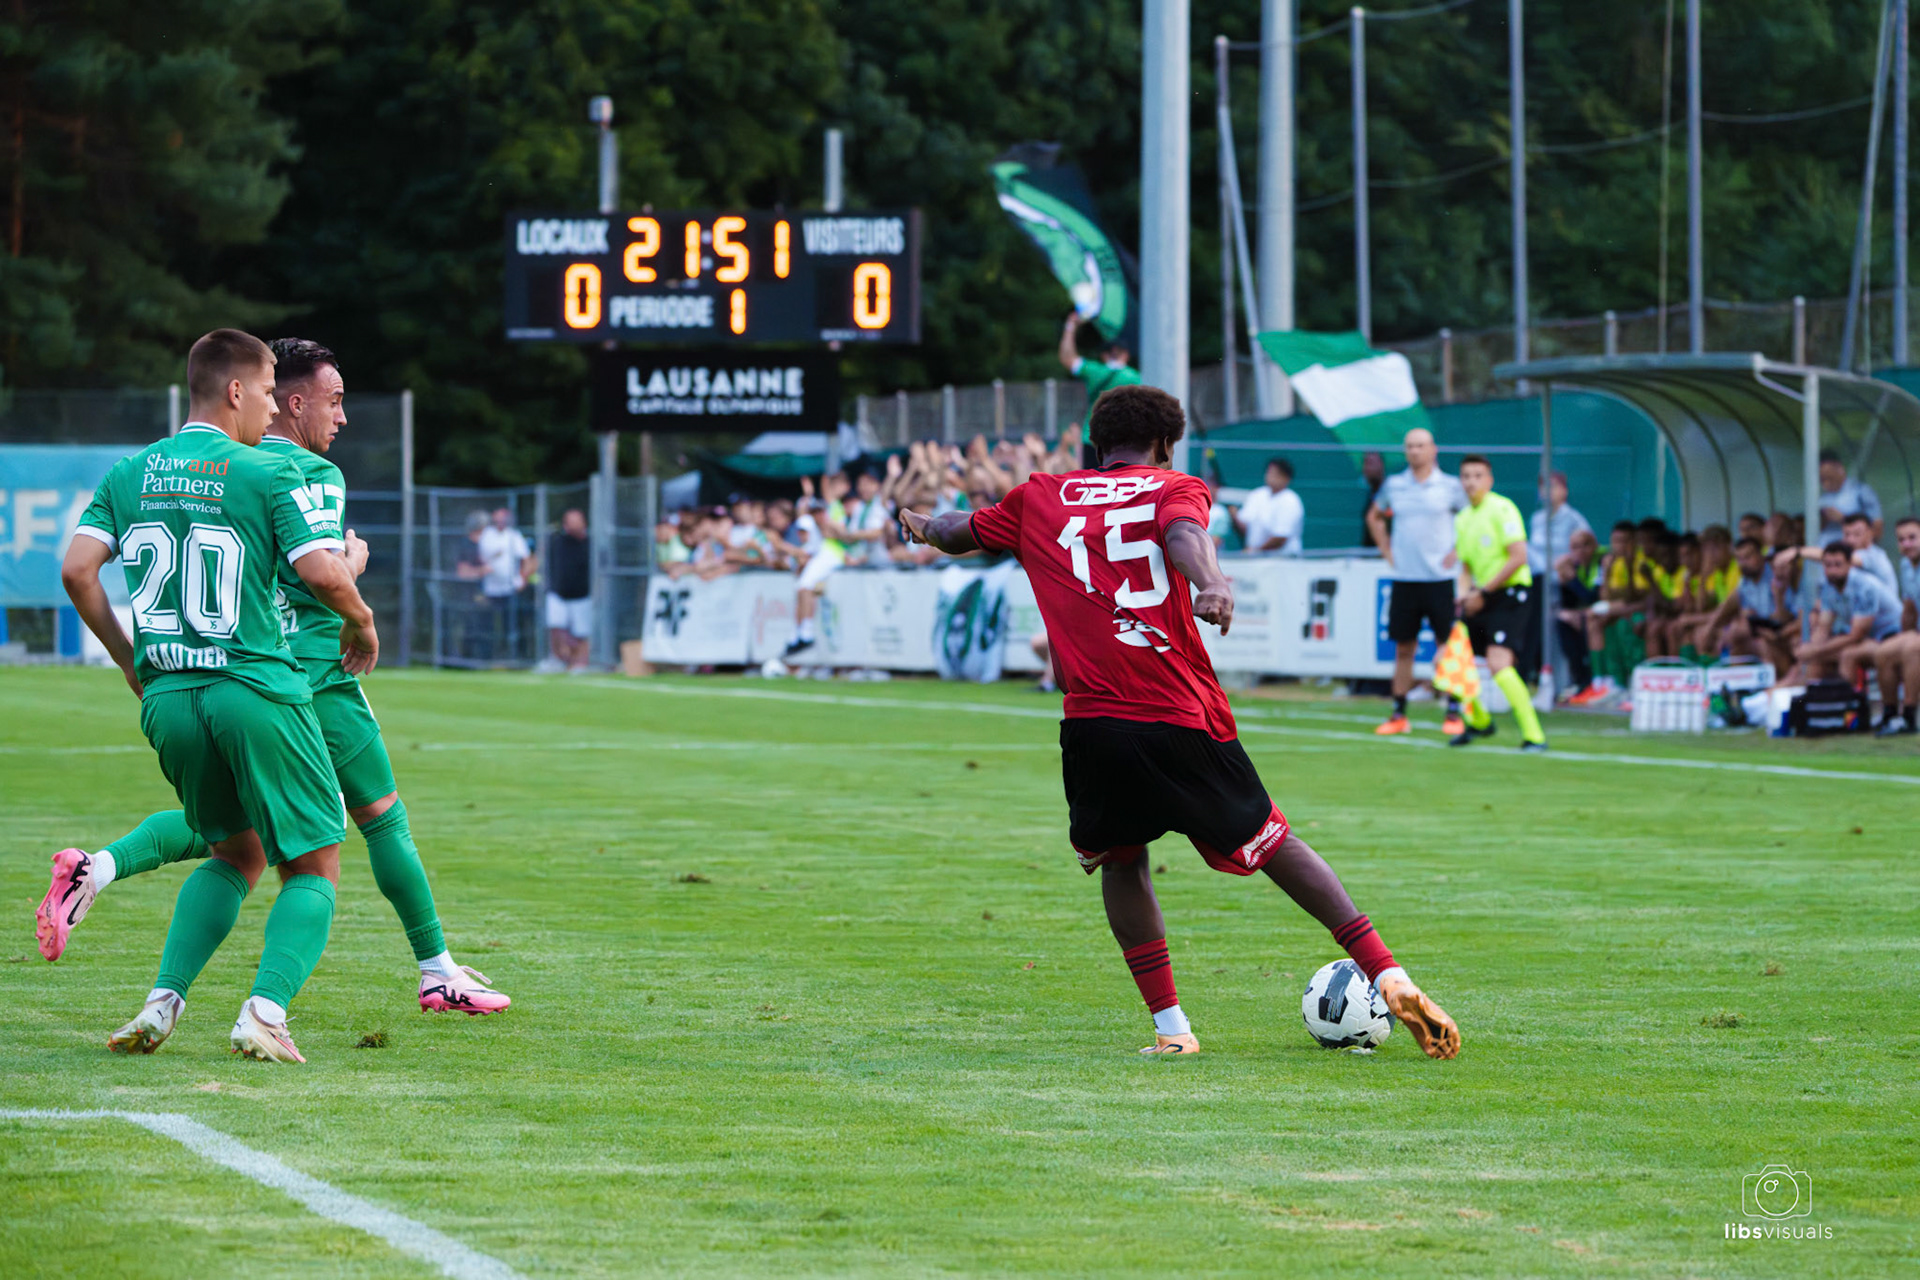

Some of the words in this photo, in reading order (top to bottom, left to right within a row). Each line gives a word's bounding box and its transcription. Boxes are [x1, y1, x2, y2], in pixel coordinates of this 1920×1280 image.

[516, 218, 610, 255] LOCAUX
[802, 217, 905, 255] VISITEURS
[563, 262, 602, 330] 0
[609, 295, 715, 328] PERIODE
[730, 288, 747, 335] 1
[853, 261, 892, 330] 0
[626, 367, 804, 398] LAUSANNE
[140, 472, 225, 497] Partners
[178, 499, 222, 515] Services
[1056, 502, 1171, 610] 15
[118, 521, 246, 640] 20
